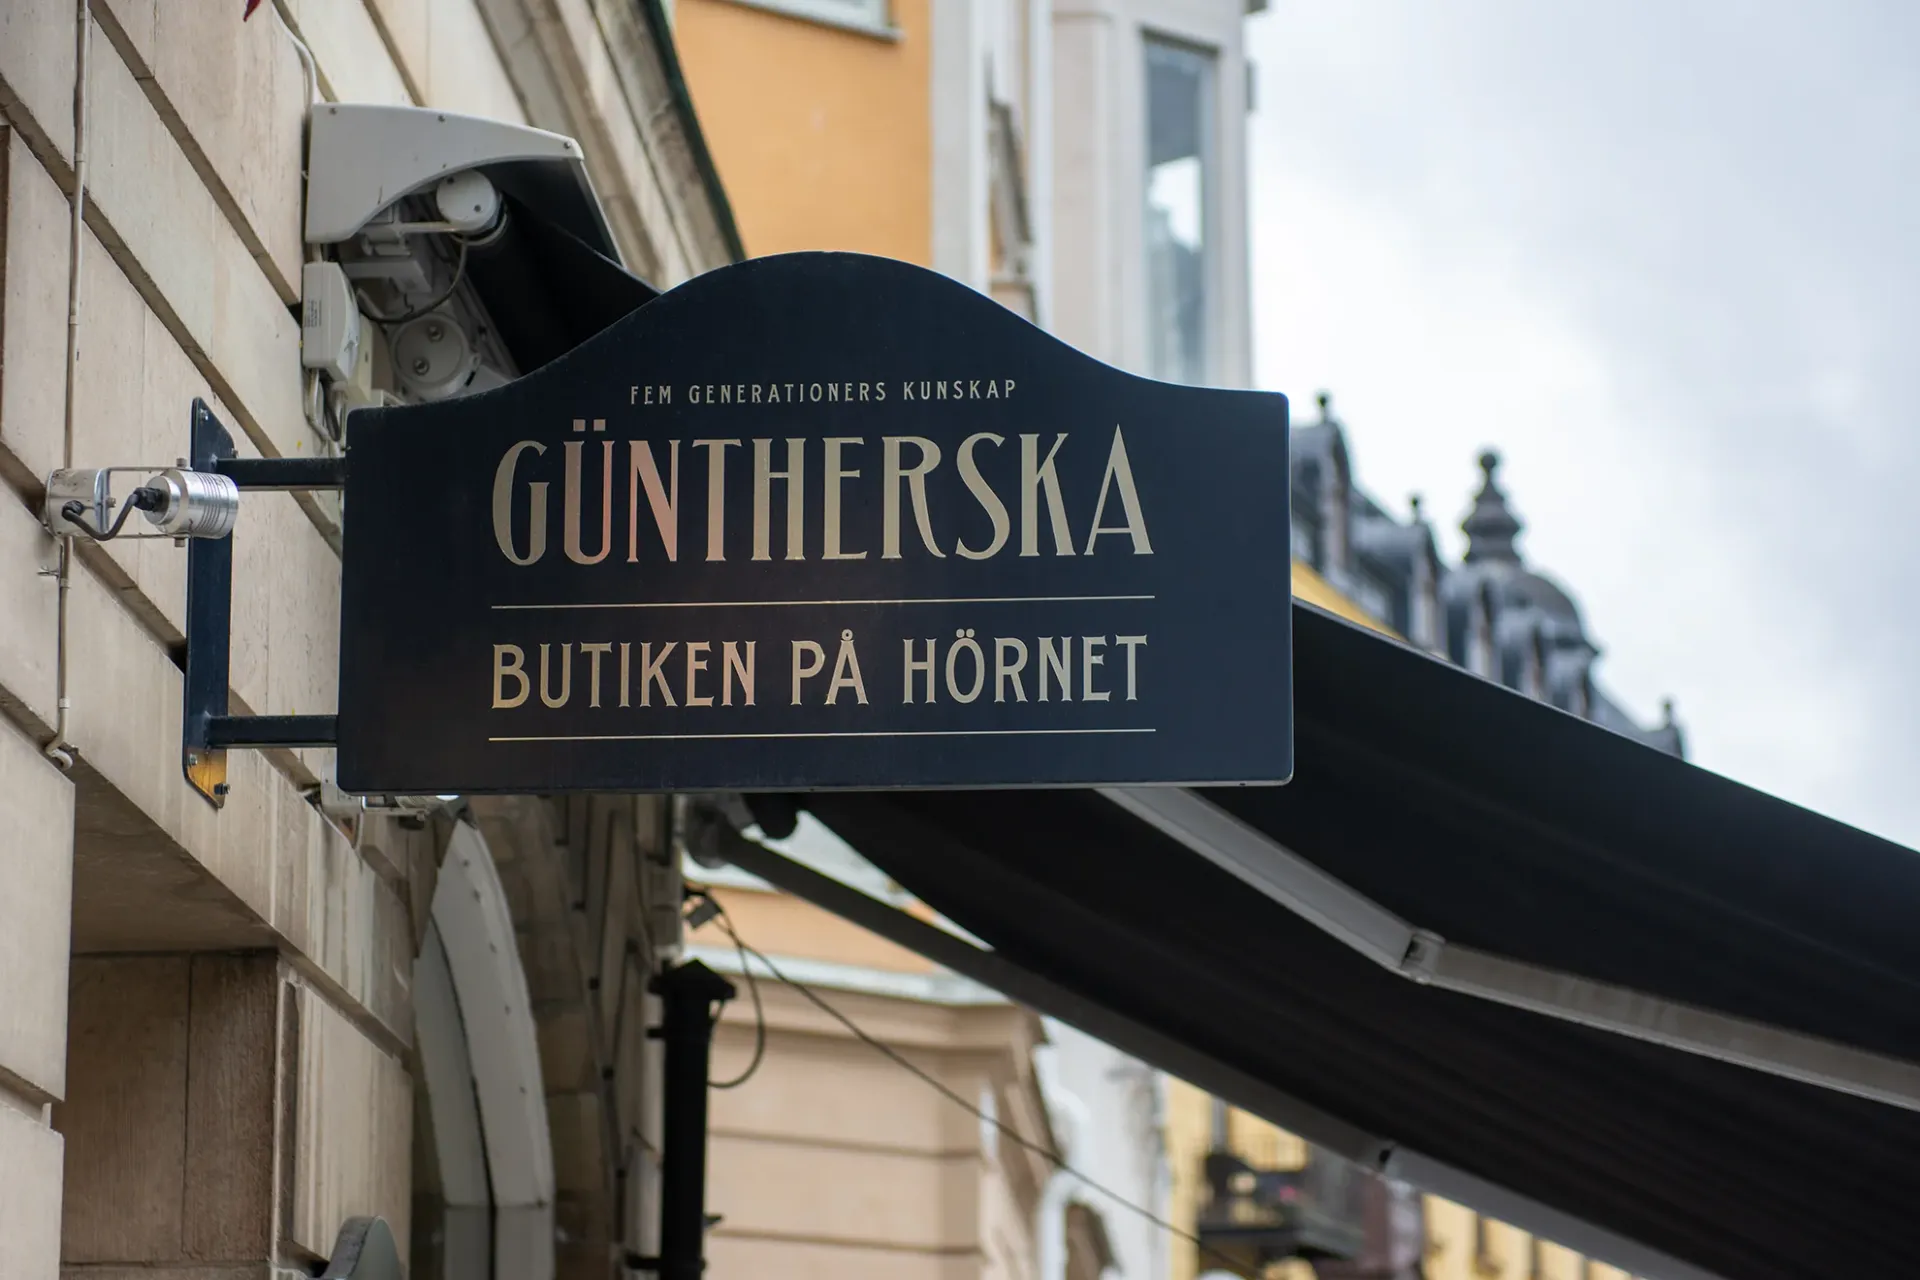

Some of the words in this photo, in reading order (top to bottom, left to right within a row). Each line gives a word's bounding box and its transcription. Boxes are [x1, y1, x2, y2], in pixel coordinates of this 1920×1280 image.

[630, 385, 672, 405] FEM
[688, 381, 887, 404] GENERATIONERS
[903, 379, 1017, 401] KUNSKAP
[492, 419, 1154, 566] GÜNTHERSKA
[491, 640, 756, 709] BUTIKEN
[790, 628, 869, 707] PÅ
[902, 628, 1148, 704] HÖRNET
